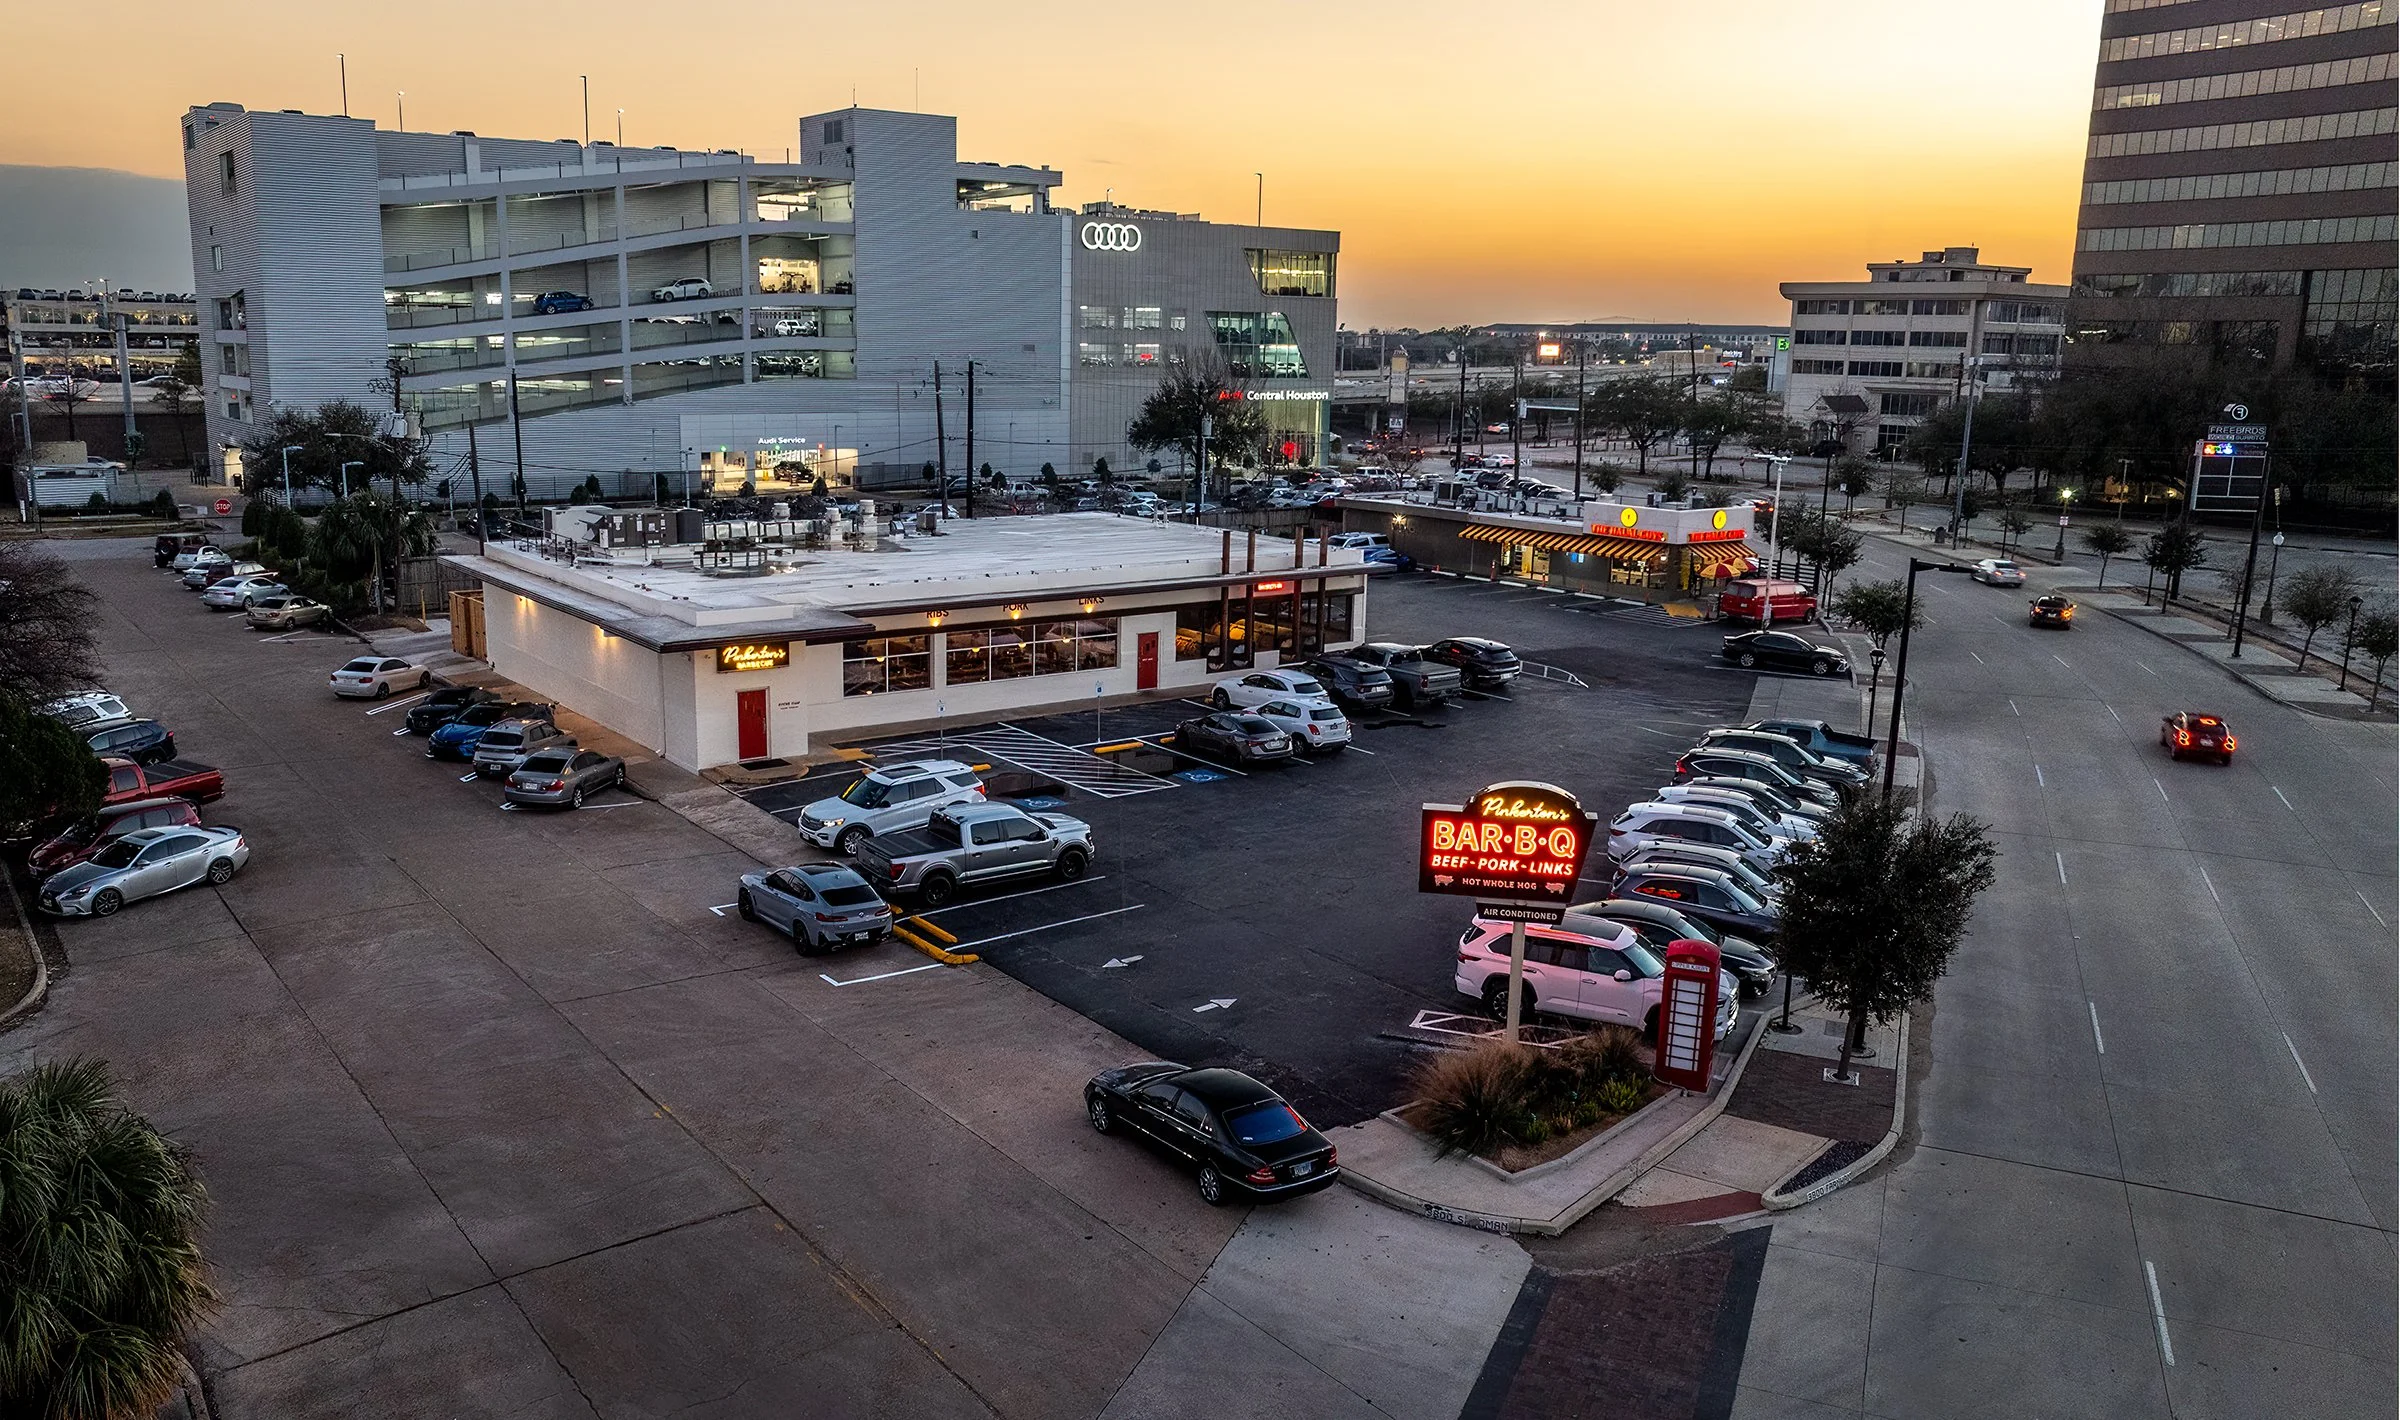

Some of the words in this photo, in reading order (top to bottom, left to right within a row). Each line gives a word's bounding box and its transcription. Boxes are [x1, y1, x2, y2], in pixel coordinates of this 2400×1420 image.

[1246, 390, 1285, 401] Central
[1286, 390, 1329, 401] Houston
[2209, 425, 2265, 435] FREEBIRDS
[778, 436, 806, 444] Service
[1591, 524, 1610, 535] THE
[1610, 526, 1639, 539] HALAL
[1641, 529, 1665, 542] GUYS
[1078, 595, 1105, 605] LINKS
[1002, 603, 1029, 612] PORK
[926, 610, 949, 618] RIBS
[723, 645, 786, 664] Pinkerton's
[736, 659, 774, 669] BARBECUE
[1481, 797, 1571, 821] Pinkerton's
[1462, 877, 1482, 887] HOT
[1482, 879, 1515, 889] WHOLE
[1517, 880, 1537, 890] HOG
[1483, 907, 1499, 916] AIR
[1500, 908, 1558, 921] CONDITIONED
